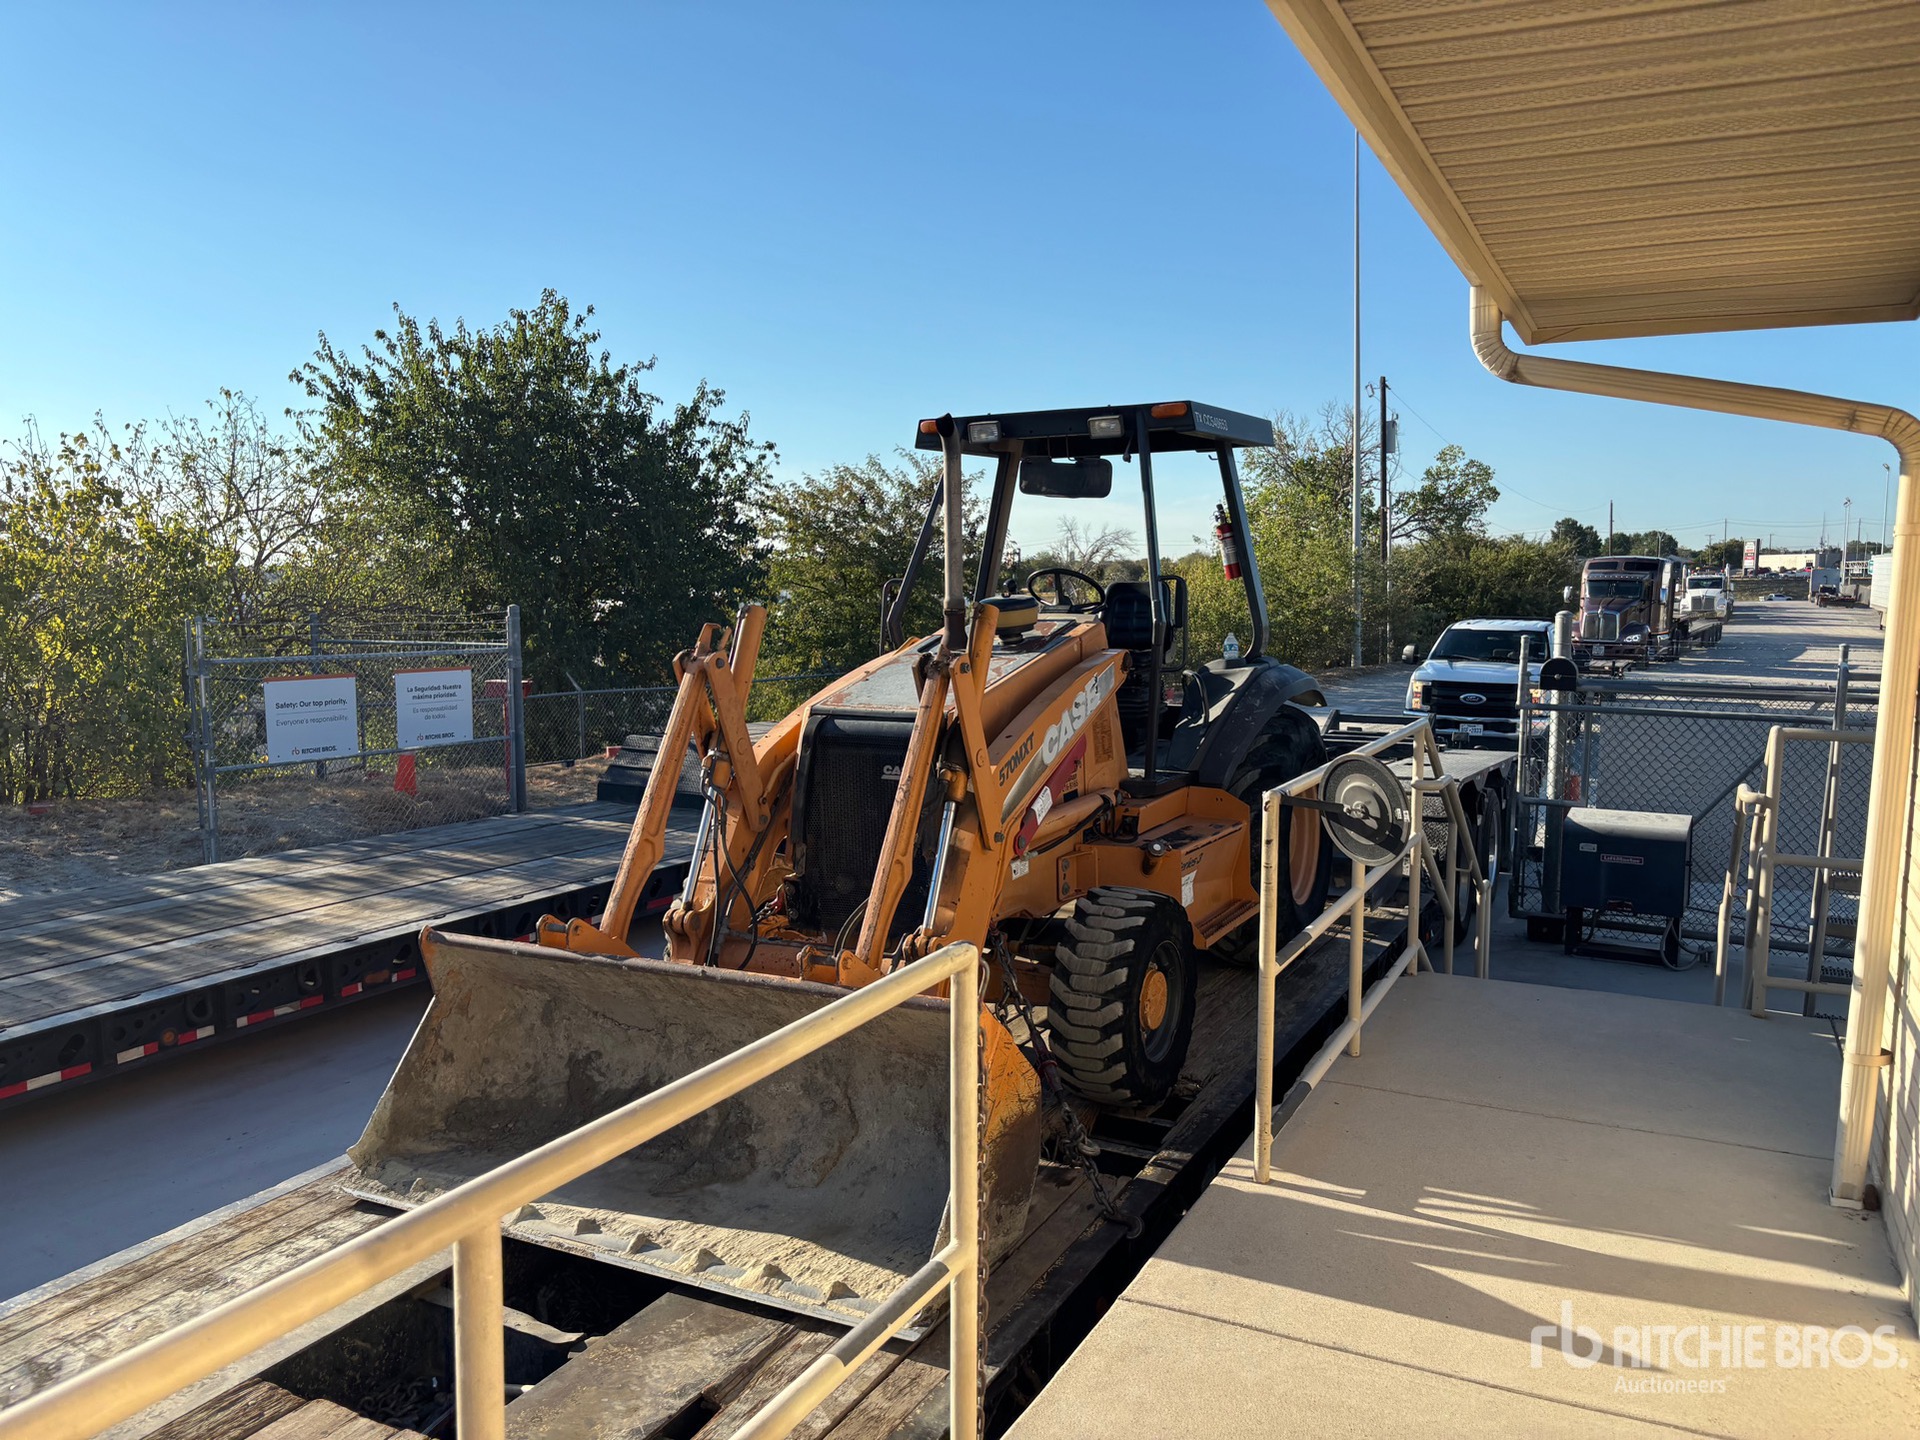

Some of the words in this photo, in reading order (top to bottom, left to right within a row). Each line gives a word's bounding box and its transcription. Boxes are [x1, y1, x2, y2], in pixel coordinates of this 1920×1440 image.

[275, 702, 298, 710] Safety:
[299, 700, 311, 708] Our
[312, 700, 323, 708] top
[324, 698, 348, 707] priority.
[276, 717, 309, 727] Everyone's
[310, 714, 348, 724] responsibility.
[1043, 671, 1101, 765] CASE
[301, 746, 321, 754] RITCHIE
[999, 732, 1034, 787] 570MXT
[883, 764, 901, 775] CA
